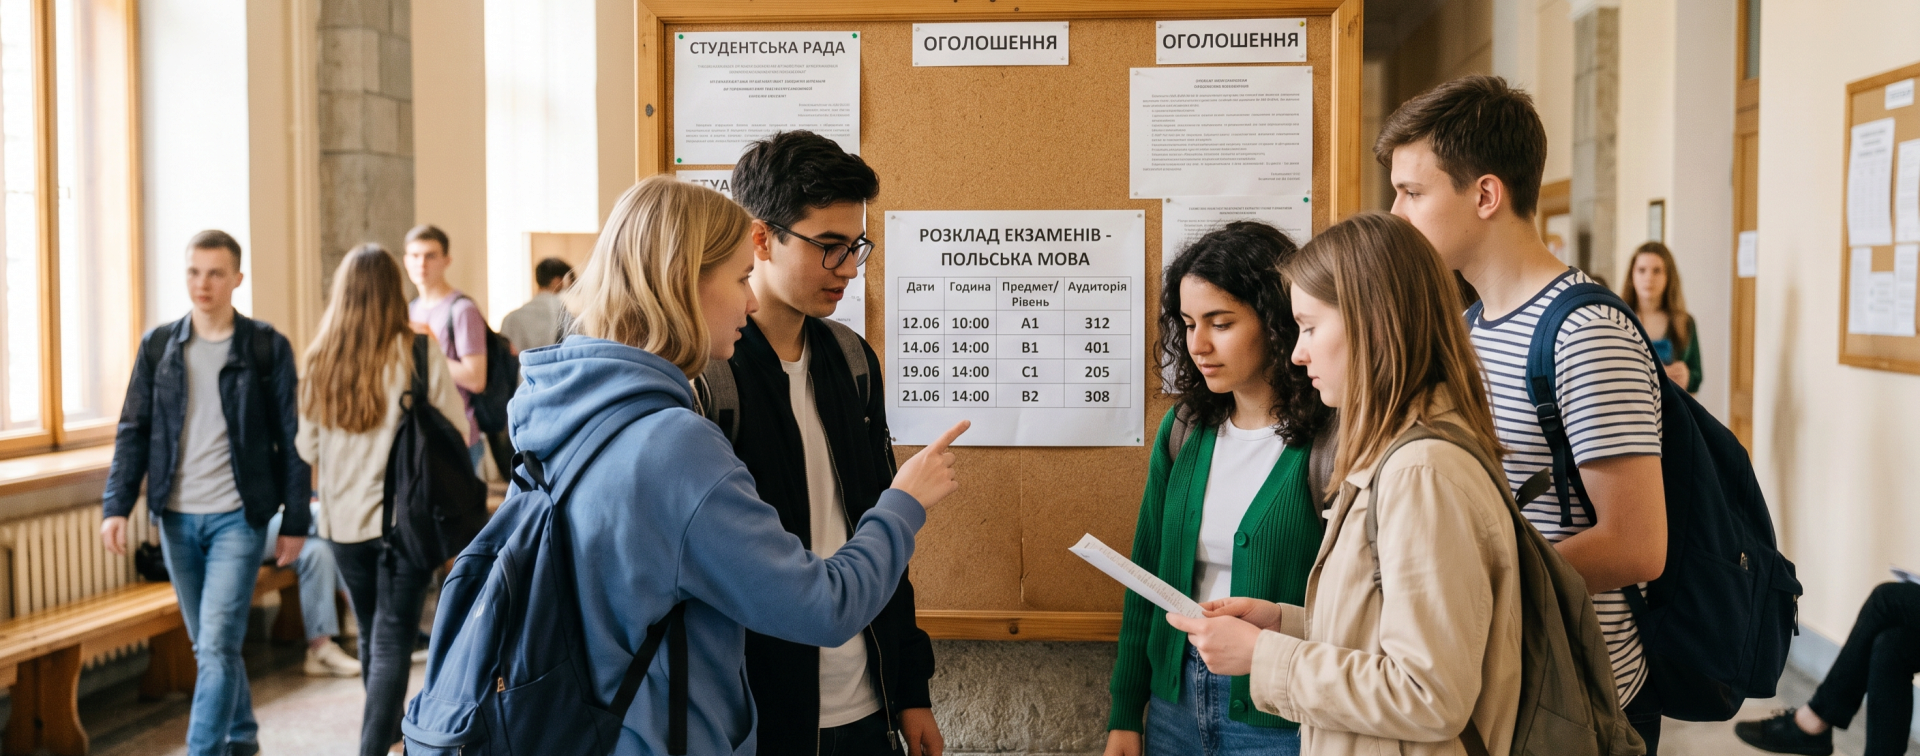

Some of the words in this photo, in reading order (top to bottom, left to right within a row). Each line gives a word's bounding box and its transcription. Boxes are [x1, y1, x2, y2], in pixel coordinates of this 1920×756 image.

[924, 35, 1056, 51] ОГОЛОШЕННЯ
[1163, 33, 1298, 49] ОГОЛОШЕННЯ
[690, 41, 798, 56] СТУДЕНТСЬКА
[804, 41, 845, 56] РАДА
[920, 228, 1000, 245] РОЗКЛАД
[1005, 227, 1101, 242] ЕКЗАМЕНІВ
[942, 252, 1032, 266] ПОЛЬСЬКА
[1038, 252, 1090, 266] МОВА
[907, 282, 934, 293] Дати
[950, 282, 990, 293] Година
[1003, 281, 1059, 293] Предмет/
[1068, 281, 1126, 293] Аудиторія
[1012, 296, 1049, 307] Рівень
[902, 317, 940, 330] 12.06
[952, 317, 990, 330] 10:00
[1085, 317, 1109, 330] 312
[902, 342, 940, 354] 14.06
[951, 342, 990, 354] 14:00
[1085, 342, 1109, 354] 401
[902, 366, 940, 378] 19.06
[951, 366, 990, 378] 14:00
[1085, 366, 1109, 378] 205
[902, 390, 940, 402] 21.06
[952, 391, 990, 403] 14:00
[1085, 391, 1109, 403] 308
